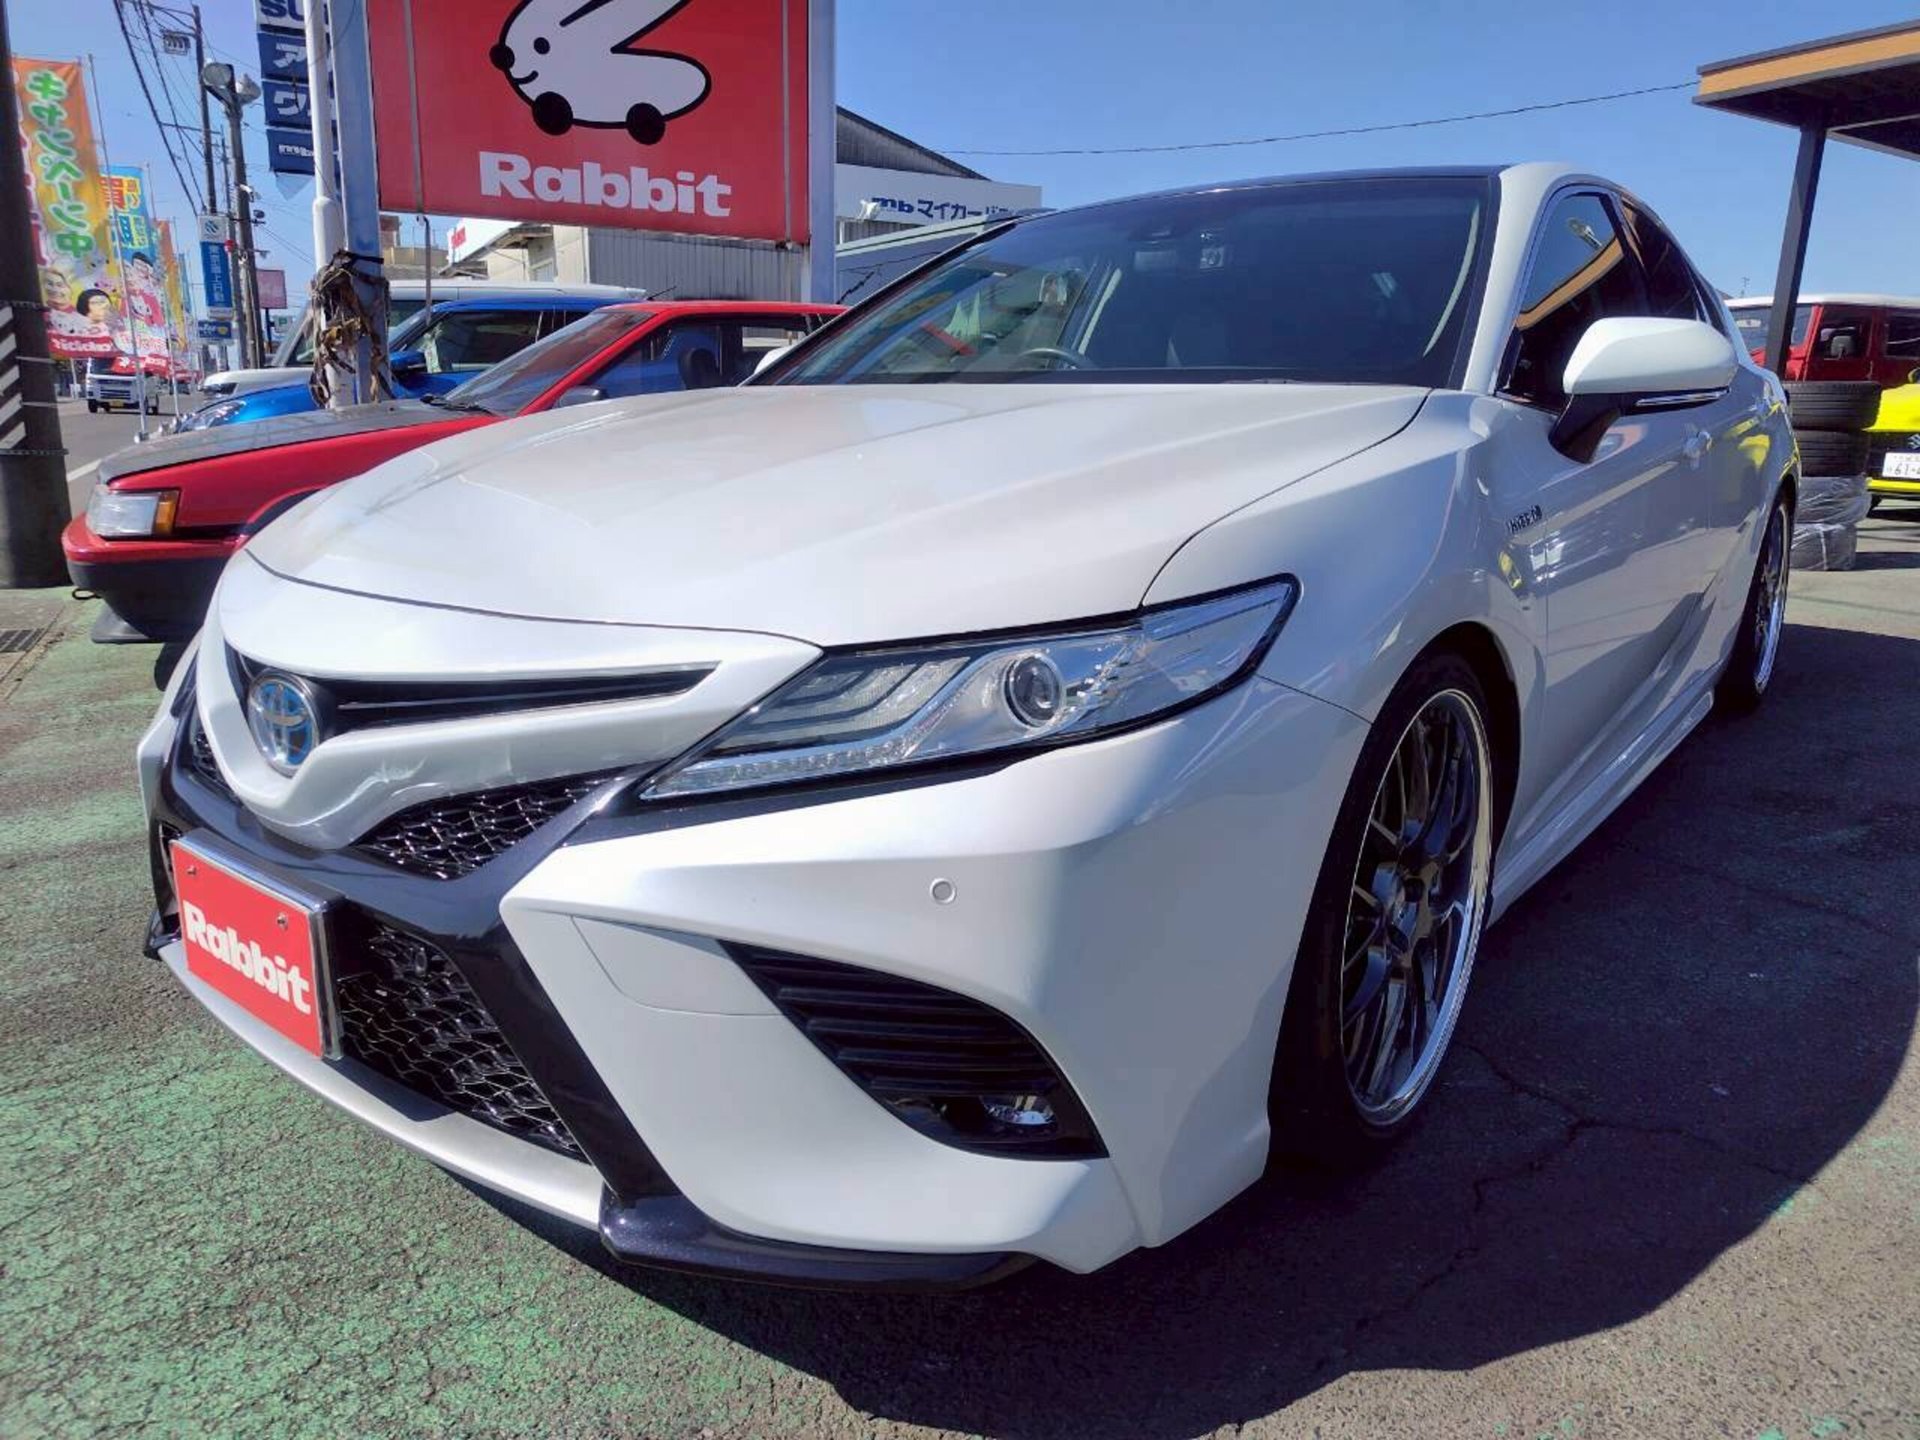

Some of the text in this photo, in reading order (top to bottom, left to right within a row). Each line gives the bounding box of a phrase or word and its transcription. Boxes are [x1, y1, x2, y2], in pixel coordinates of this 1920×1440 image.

[26, 70, 95, 259] キャンペーン中
[479, 151, 732, 217] Rabbit
[182, 899, 312, 1015] Rabbit
